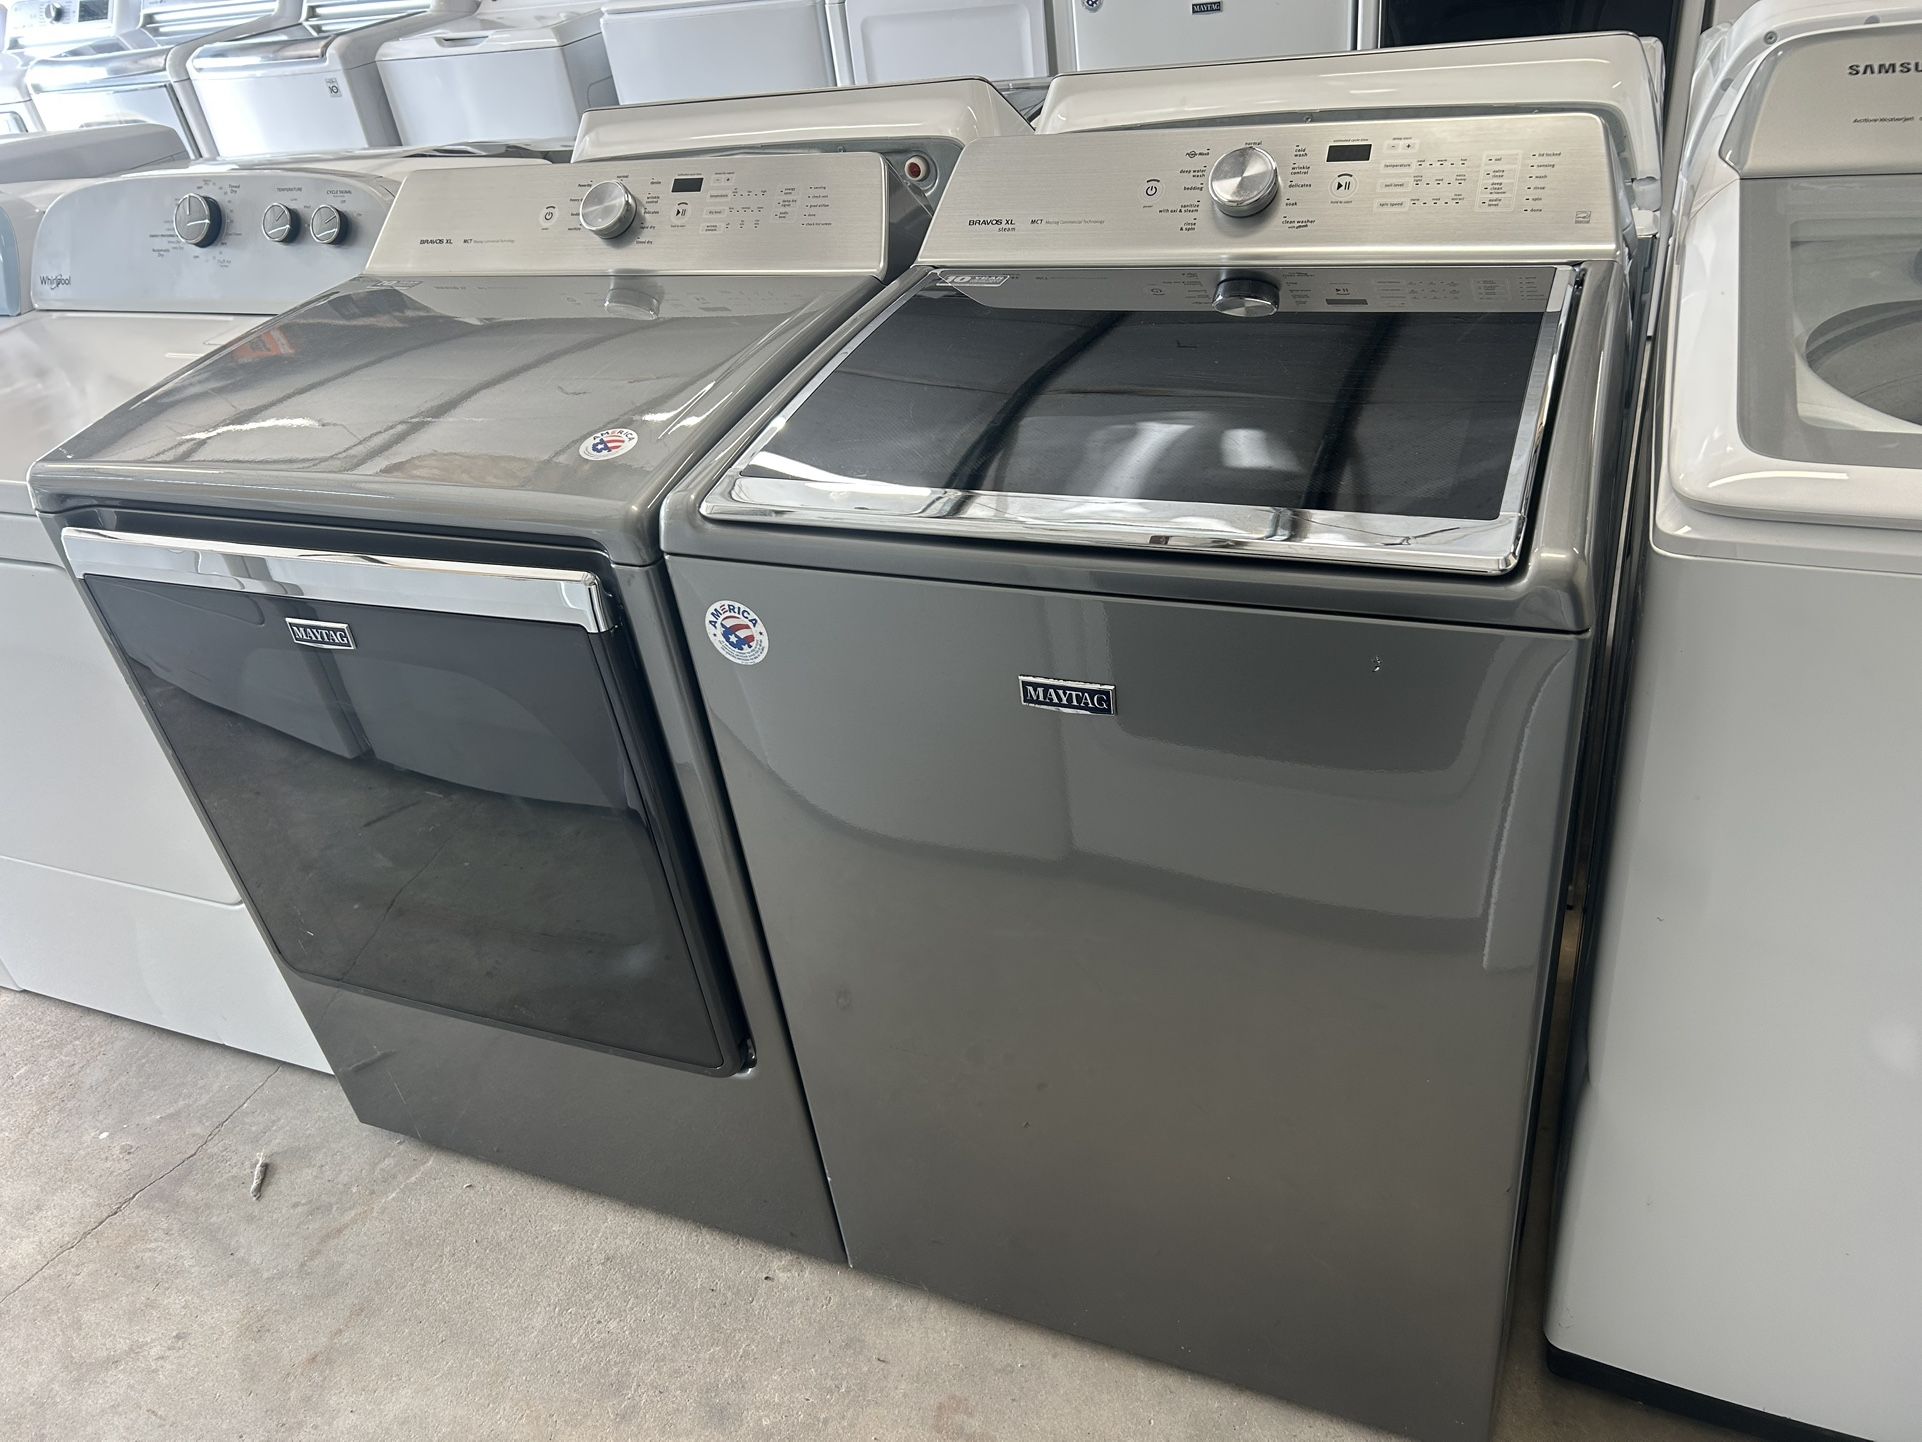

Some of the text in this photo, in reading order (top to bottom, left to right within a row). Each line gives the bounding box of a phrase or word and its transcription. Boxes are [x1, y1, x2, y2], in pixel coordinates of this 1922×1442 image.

[1193, 3, 1220, 12] MAYTAG
[40, 274, 71, 290] Whirlpool
[709, 604, 758, 629] AMERICA
[292, 626, 348, 644] MAYTAG
[1025, 685, 1108, 709] MAYTAG
